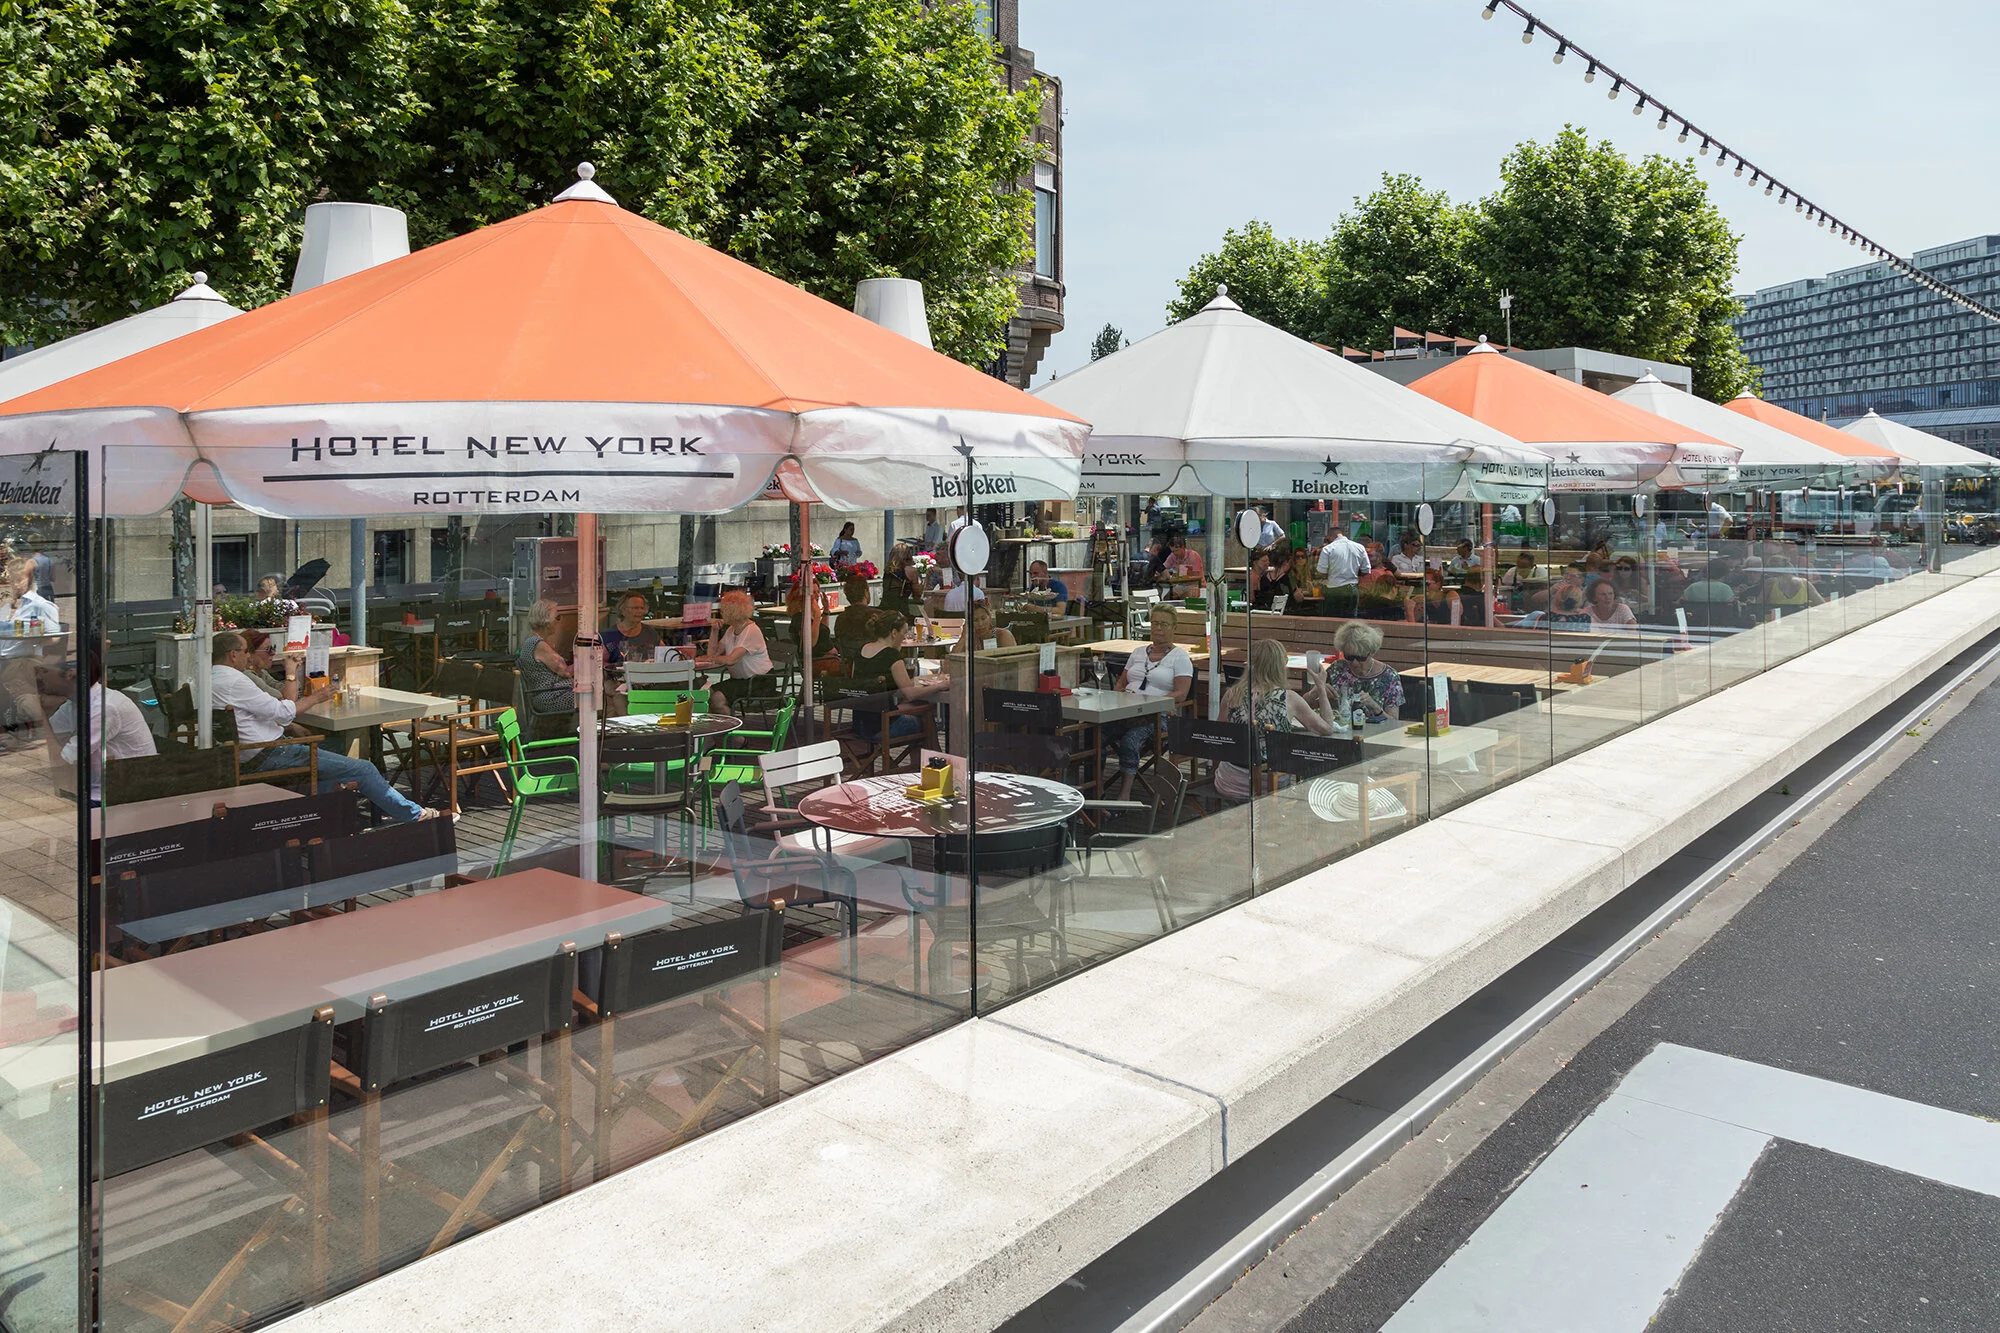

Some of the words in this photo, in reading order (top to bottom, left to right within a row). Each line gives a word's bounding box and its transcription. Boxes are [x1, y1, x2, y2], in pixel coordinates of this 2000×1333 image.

[291, 436, 445, 462] HOTEL
[467, 436, 567, 459] NEW
[585, 436, 706, 458] YORK
[1092, 453, 1146, 466] YORK
[1481, 462, 1507, 475] HOTEL
[1508, 465, 1523, 477] NEW
[1524, 467, 1543, 479] YORK
[1551, 467, 1606, 478] Heineken
[1740, 468, 1766, 477] NEW
[1770, 467, 1801, 476] YORK
[1291, 479, 1369, 495] Heineken
[413, 489, 580, 505] ROTTERDAM
[254, 819, 279, 828] HOTEL
[110, 852, 137, 861] HOTEL
[140, 847, 158, 855] NEW
[160, 842, 181, 851] YORK
[656, 955, 686, 967] HOTEL
[688, 949, 709, 960] NEW
[711, 944, 735, 955] YORK
[677, 959, 714, 971] ROTTERDAM
[429, 1011, 464, 1027] HOTEL
[467, 1003, 490, 1016] NEW
[493, 994, 519, 1008] YORK
[453, 1013, 496, 1029] ROTTERDAM
[144, 1094, 189, 1114] HOTEL
[194, 1083, 223, 1098] NEW
[227, 1071, 261, 1087] YORK
[176, 1094, 231, 1115] ROTTERDAM
